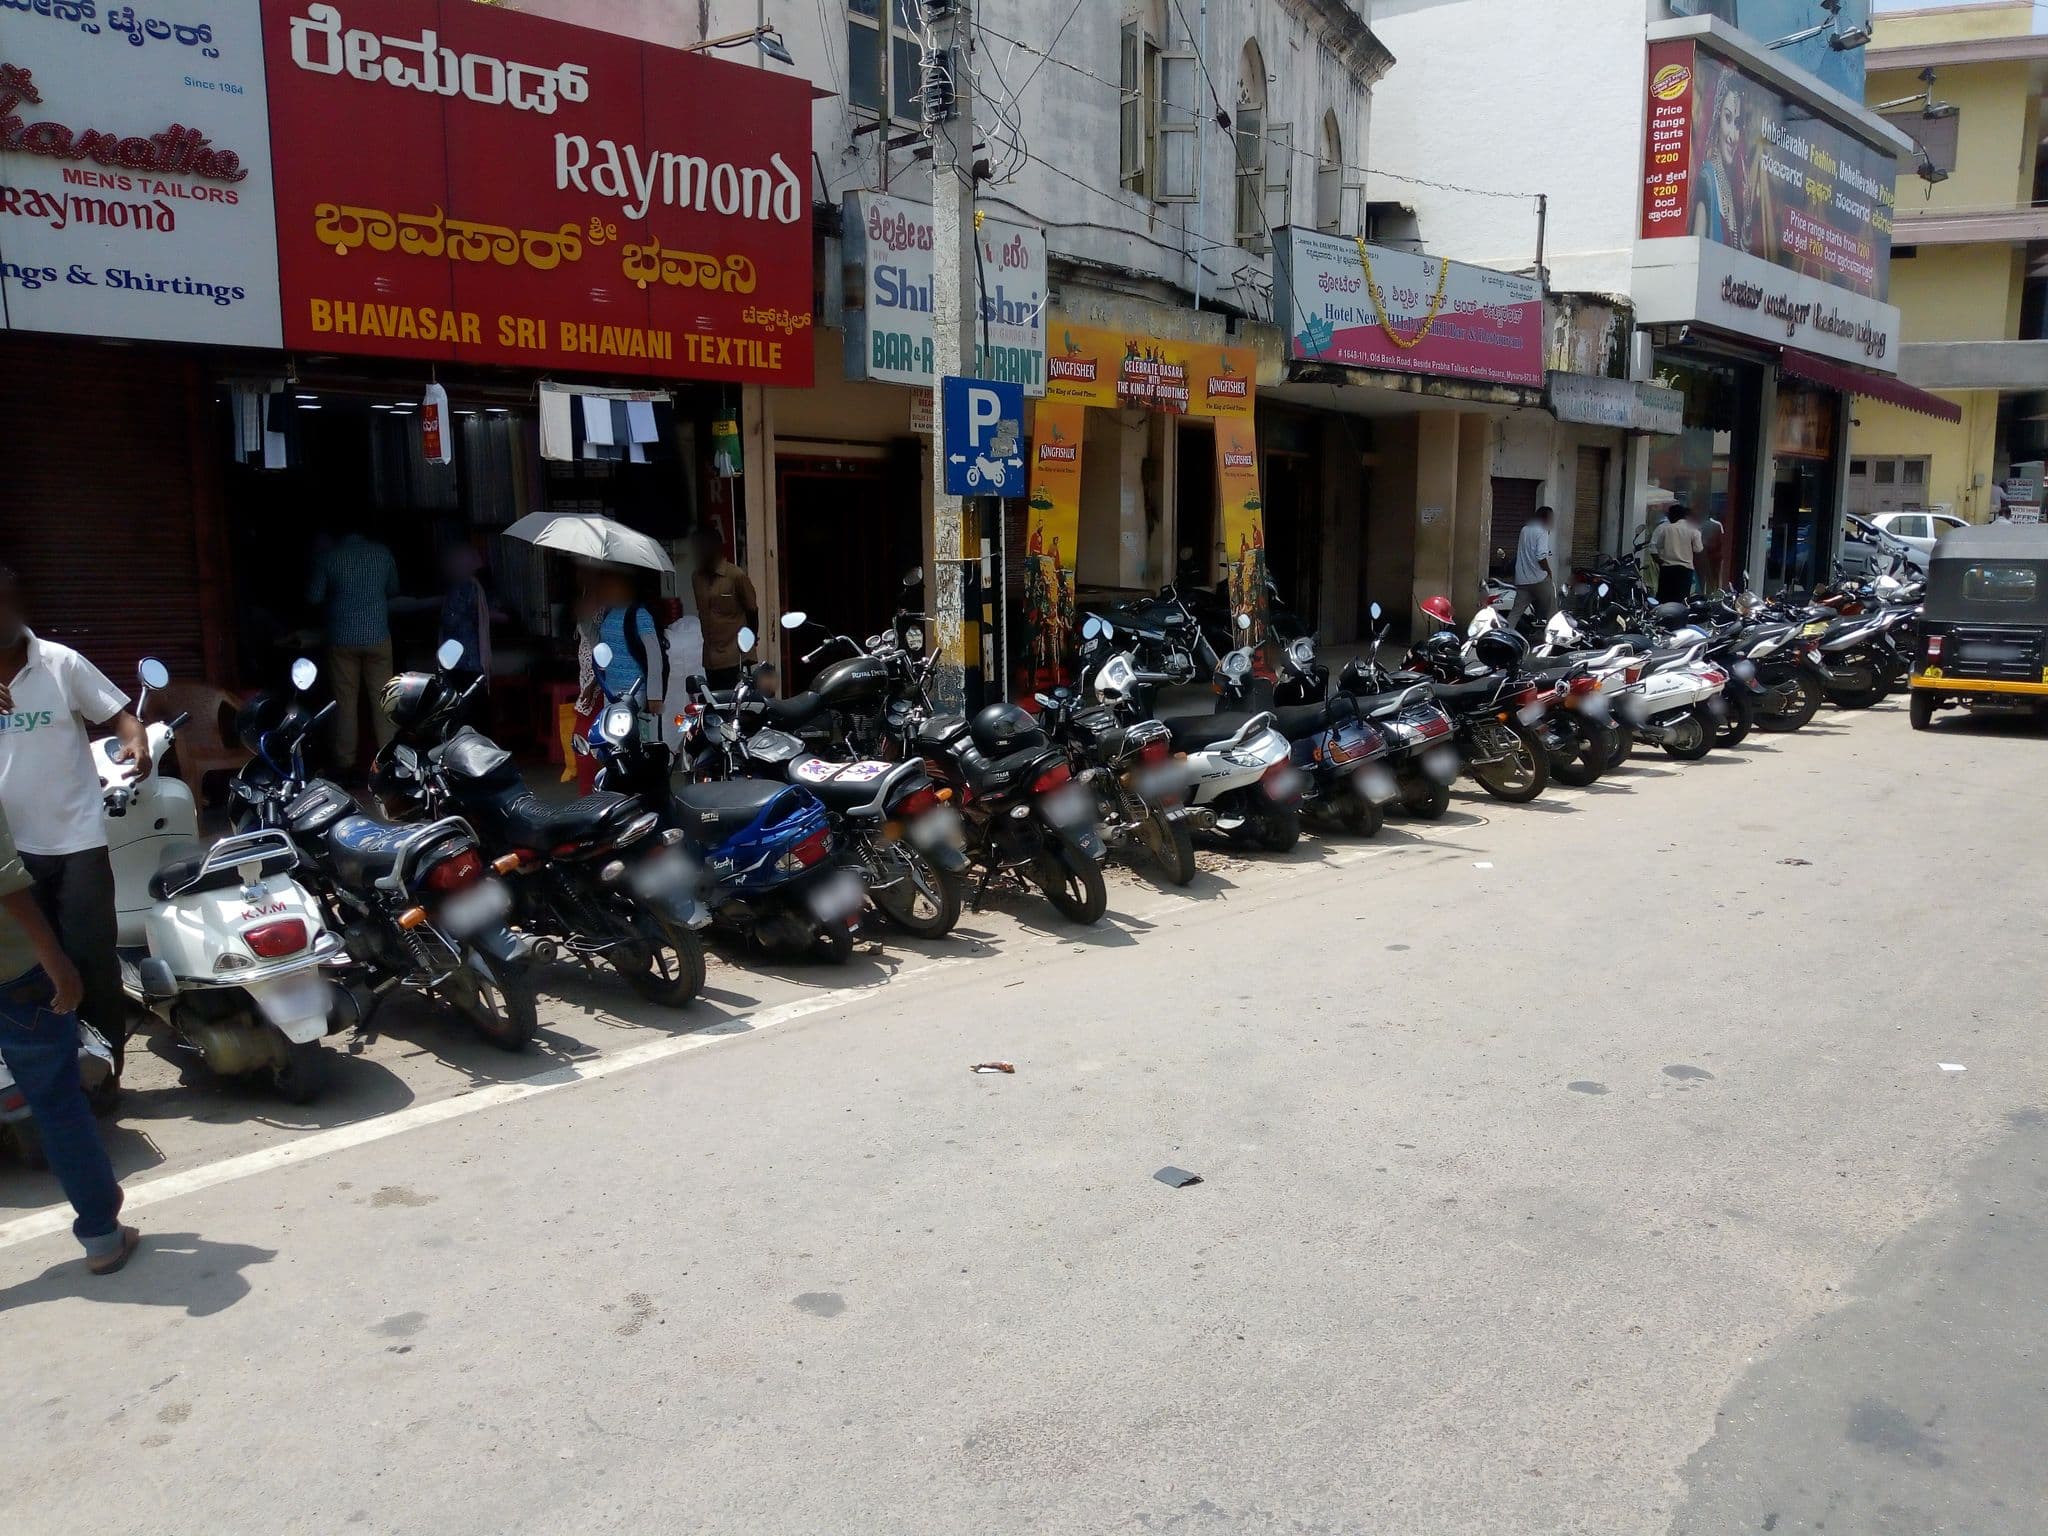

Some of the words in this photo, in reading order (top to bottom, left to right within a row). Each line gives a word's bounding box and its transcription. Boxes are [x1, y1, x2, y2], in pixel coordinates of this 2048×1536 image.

[108, 7, 219, 58] ಟೈಲರ್ಸ್
[290, 2, 589, 114] ರೇಮಂಡ್
[184, 76, 215, 90] Since
[219, 82, 244, 95] 1964
[1656, 106, 1683, 117] Price
[1652, 118, 1686, 130] Range
[1653, 131, 1684, 141] Starts
[1653, 143, 1682, 153] From
[1655, 153, 1680, 163] ₹200
[1762, 116, 1809, 162] Unbelievable
[1810, 144, 1838, 181] Fashion,
[1839, 160, 1879, 201] Unbelievable
[63, 168, 132, 191] MEN'S
[138, 179, 239, 205] TAILORS
[554, 133, 800, 224] Raymond
[1653, 185, 1679, 196] ₹200
[0, 185, 176, 232] Raymond
[1790, 210, 1807, 231] Price
[1807, 221, 1825, 241] range
[1825, 229, 1843, 248] starts
[1843, 235, 1857, 254] from
[315, 202, 582, 270] ಭಾವಸಾರ್
[588, 216, 617, 245] ಶ್ರೀ
[622, 234, 757, 294] ಭವಾನಿ
[66, 264, 97, 285] &
[105, 268, 245, 305] Shirtings
[1325, 303, 1353, 325] Hotel
[1356, 308, 1378, 325] New
[1468, 328, 1477, 342] &
[310, 298, 481, 344] BHAVASAR
[498, 315, 547, 350] SRI
[560, 321, 672, 360] BHAVANI
[684, 333, 782, 370] TEXTILE
[873, 331, 913, 372] BAR
[914, 346, 921, 361] &
[1050, 358, 1096, 380] KINGFISHER
[1124, 360, 1159, 375] CELEBRATE
[1160, 364, 1183, 378] DASARA
[1370, 353, 1380, 362] Old
[1381, 354, 1396, 364] Bank
[1396, 356, 1413, 367] Road,
[1413, 358, 1431, 369] Beside
[1432, 360, 1450, 371] Prabha
[1470, 365, 1488, 375] Gandhi
[1117, 381, 1128, 394] THE
[1146, 384, 1155, 397] OF
[1209, 377, 1246, 396] KINGFISHER
[968, 388, 1001, 447] P
[1040, 444, 1075, 460] KINGFISHER
[1225, 452, 1253, 466] KINGFISHER
[241, 901, 287, 920] K.V.M
